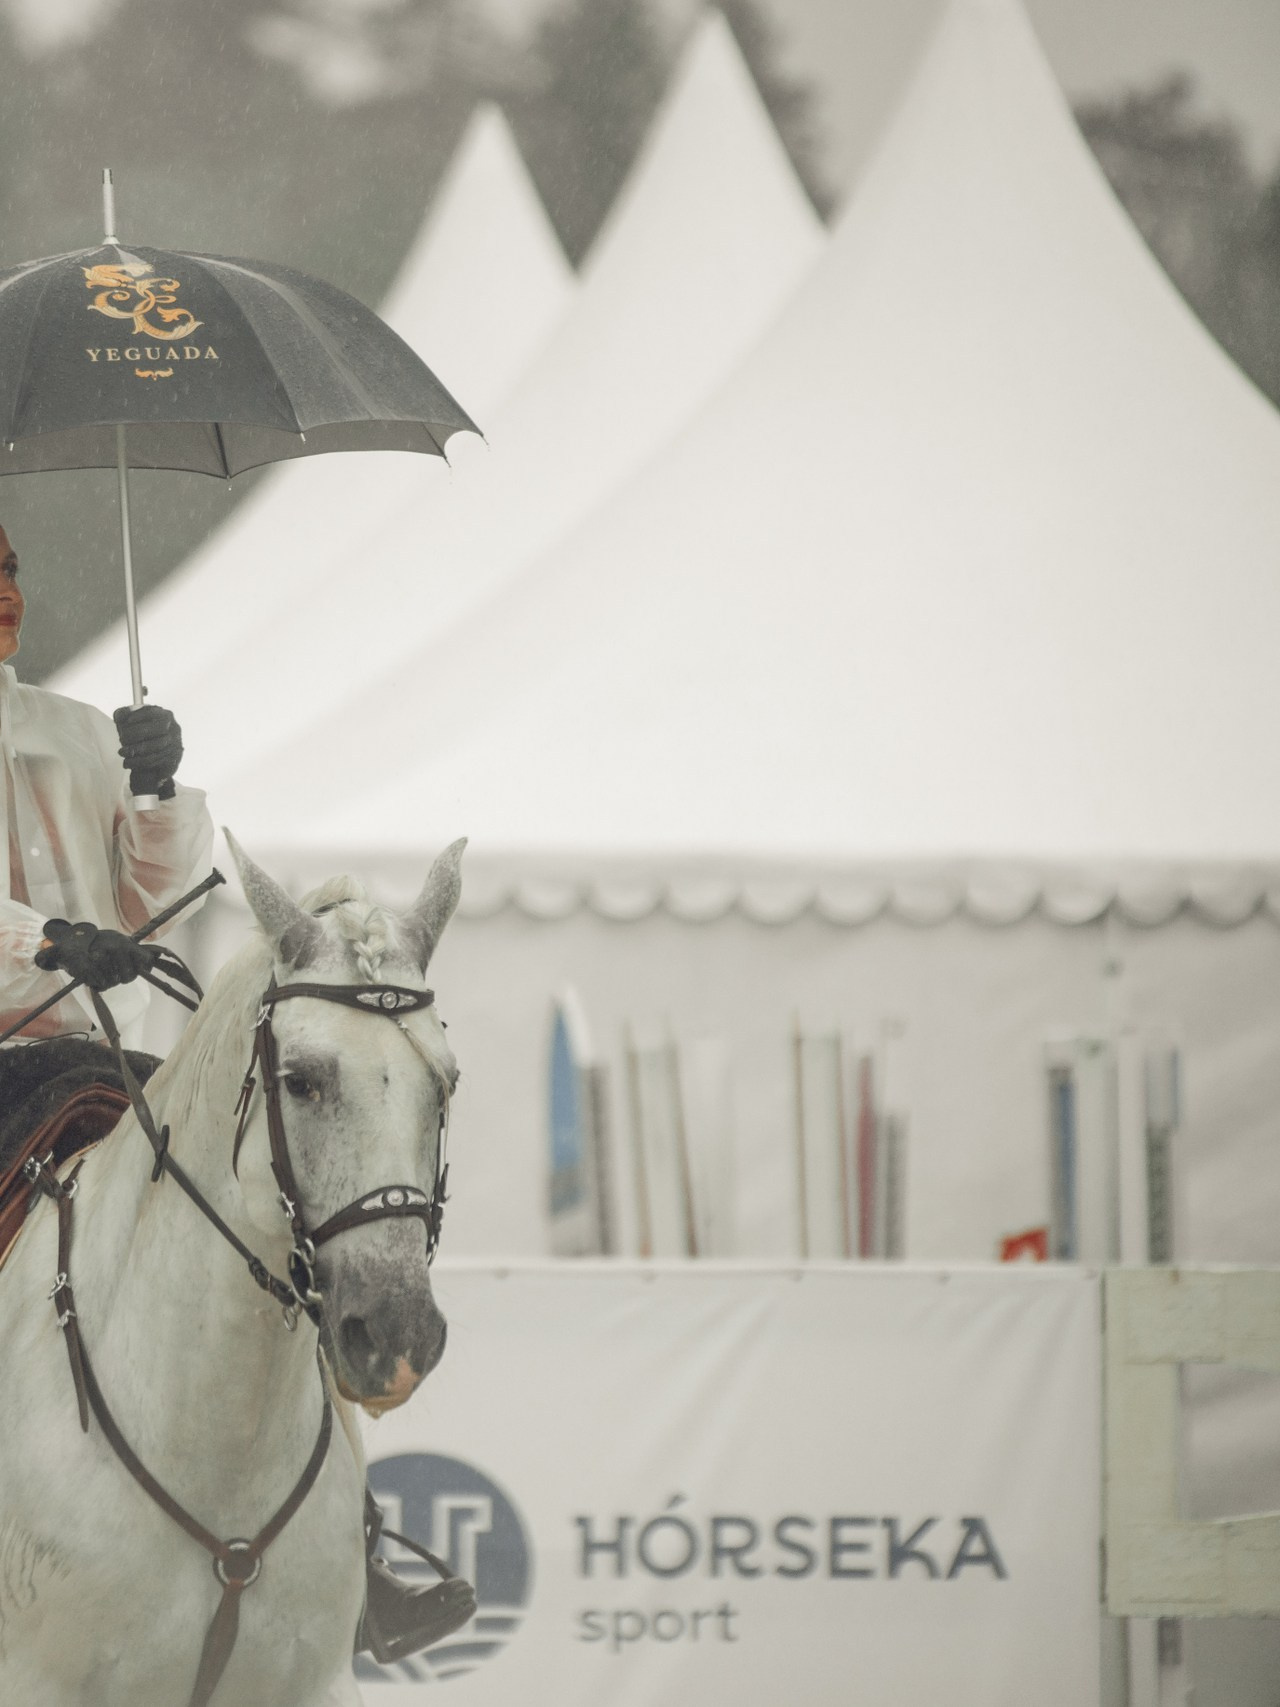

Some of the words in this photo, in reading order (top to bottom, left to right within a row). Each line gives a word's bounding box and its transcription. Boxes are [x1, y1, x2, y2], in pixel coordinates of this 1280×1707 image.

[86, 346, 219, 362] YEGUADA
[572, 1494, 1010, 1581] HÓRSEKA
[577, 1600, 739, 1652] sport
